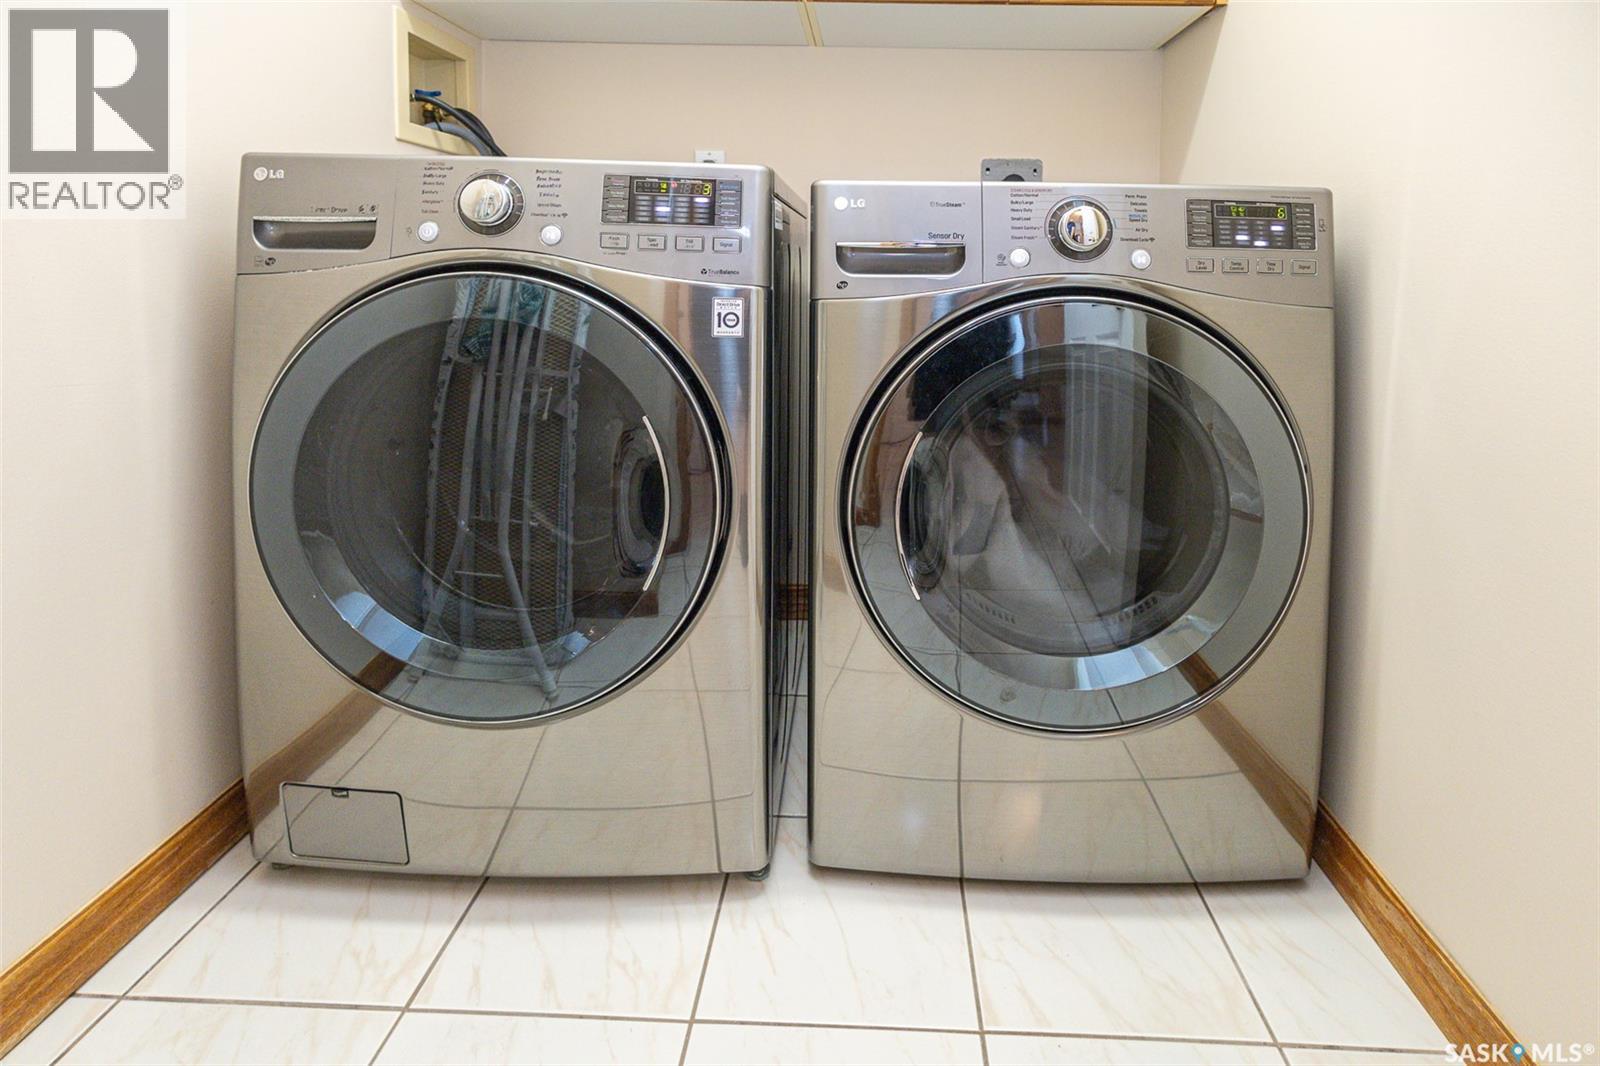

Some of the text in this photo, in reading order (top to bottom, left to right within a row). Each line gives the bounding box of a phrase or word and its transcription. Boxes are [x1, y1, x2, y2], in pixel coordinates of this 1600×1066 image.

[269, 169, 285, 179] LG
[702, 182, 711, 196] 3
[850, 199, 866, 209] LG
[1276, 206, 1286, 219] 6
[927, 231, 966, 242] Sensor Dry
[708, 268, 740, 276] TrueBalance
[716, 311, 740, 329] 10
